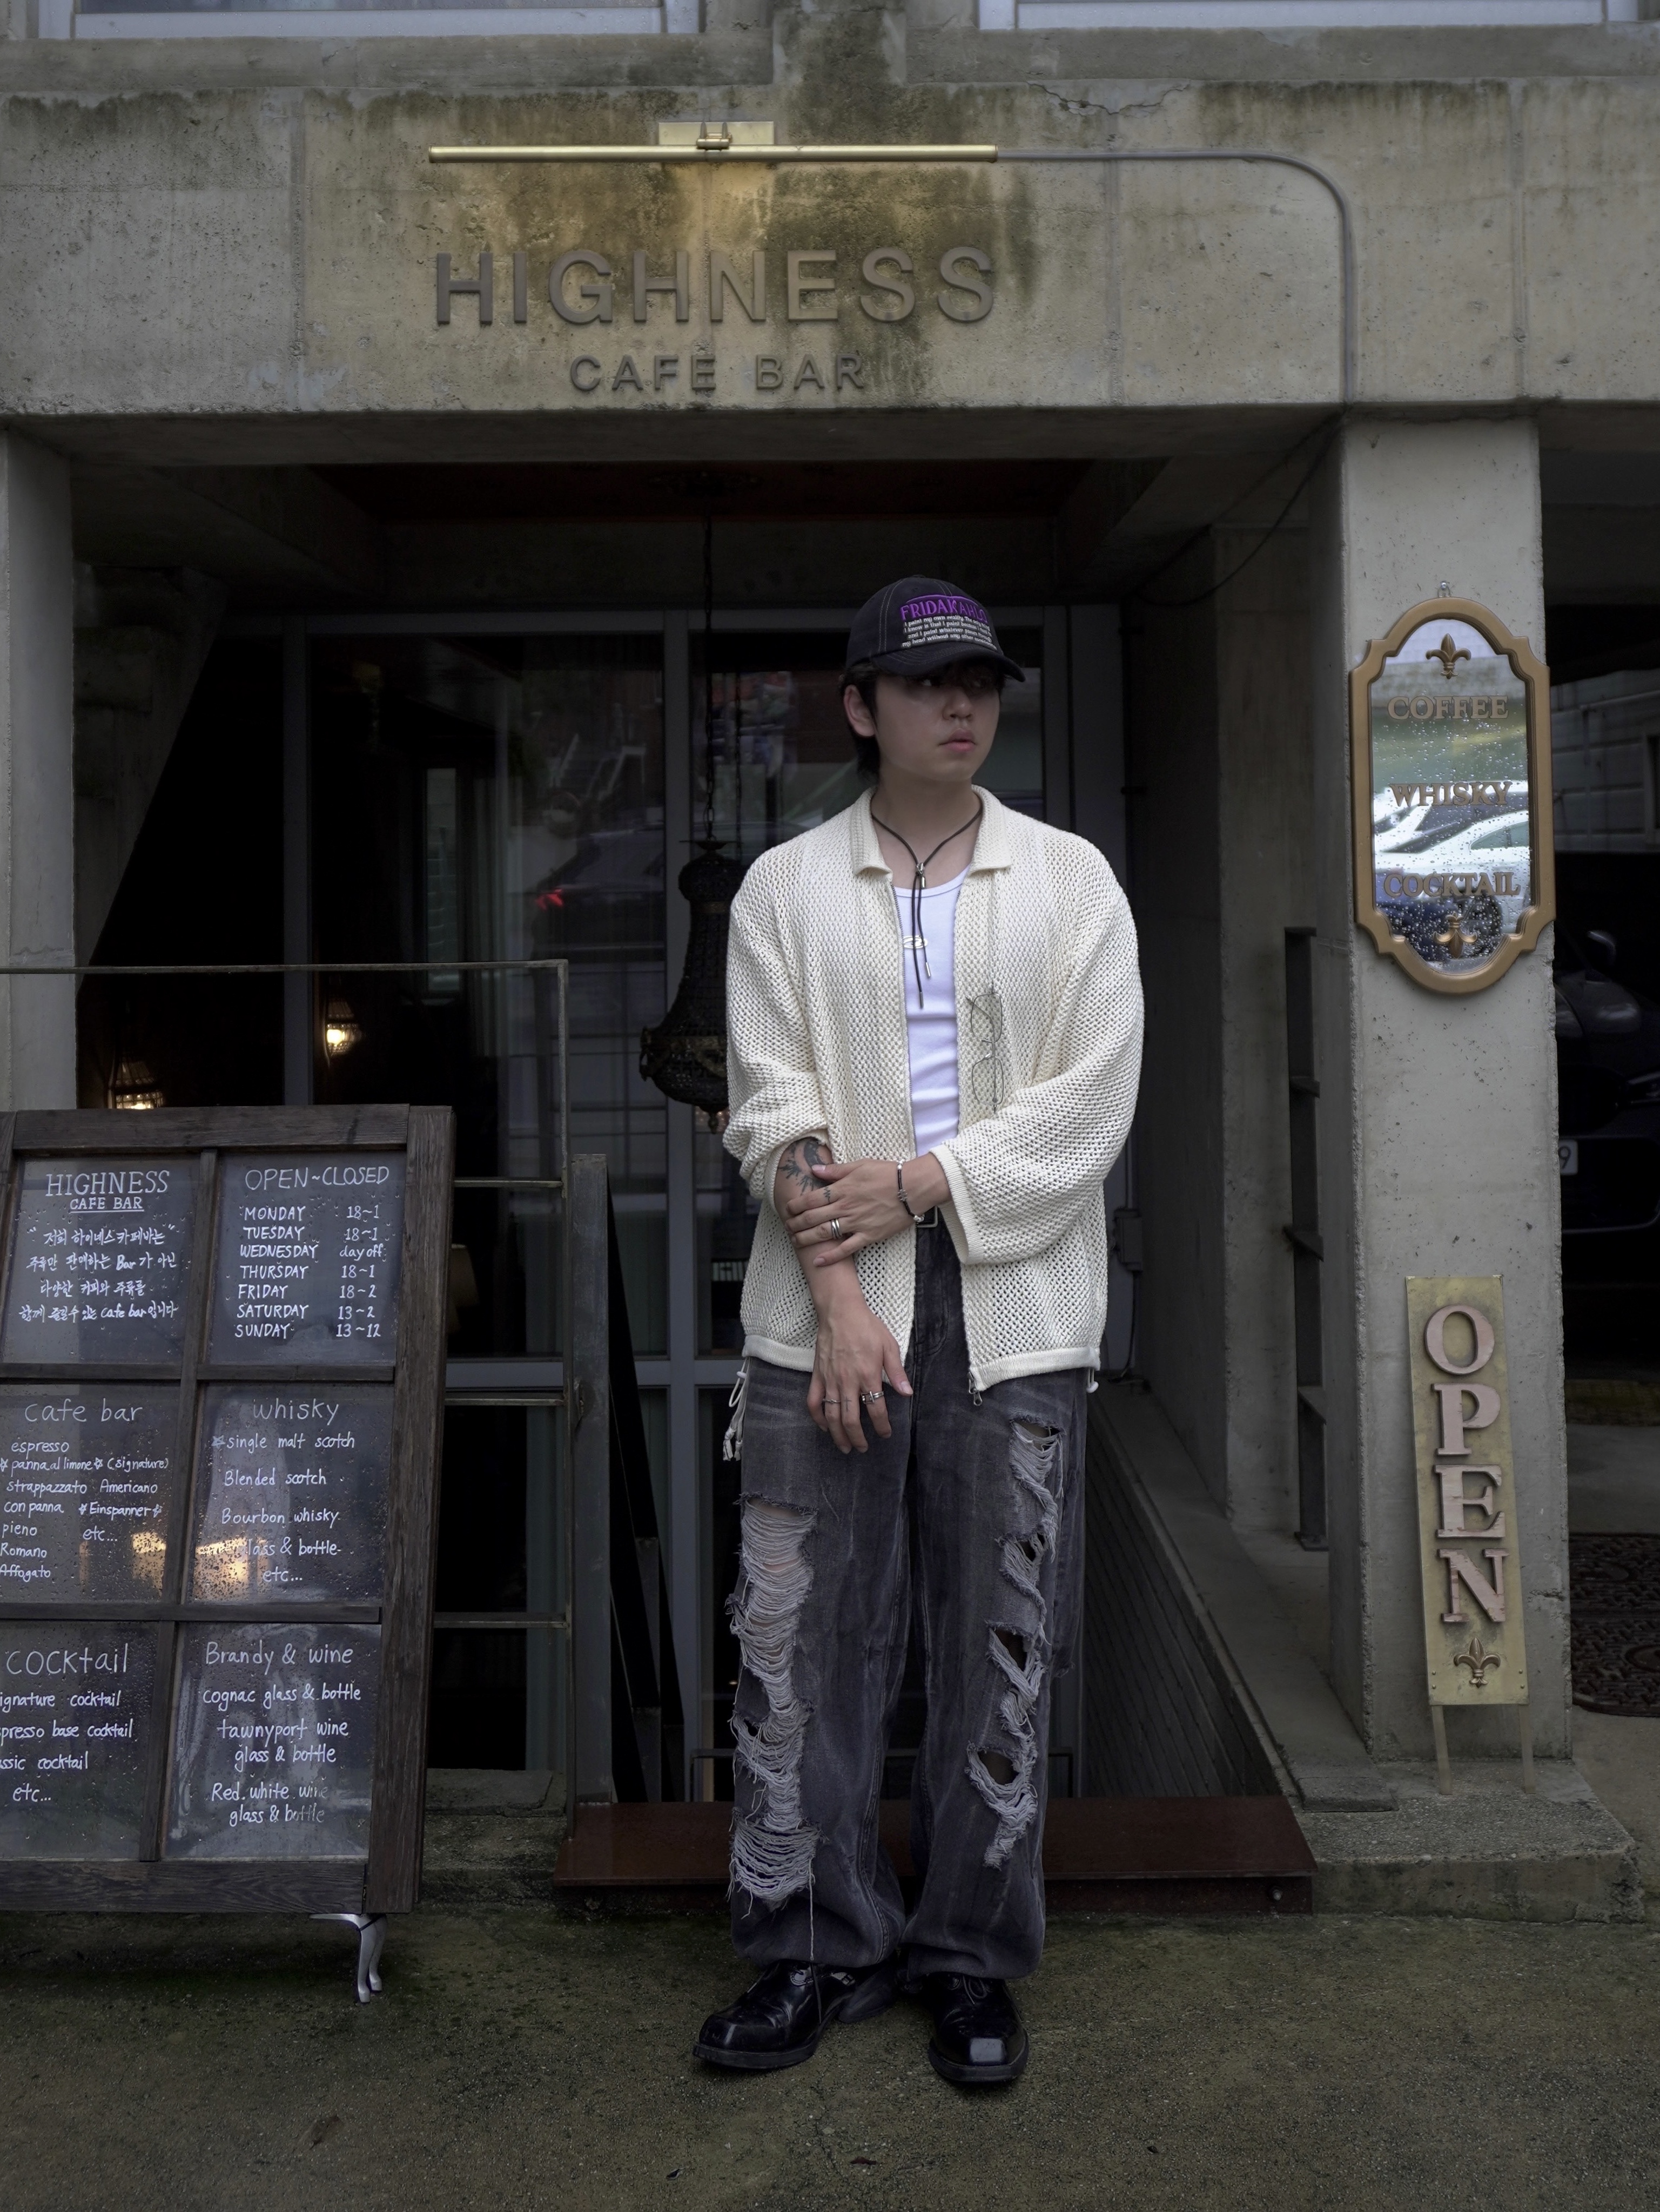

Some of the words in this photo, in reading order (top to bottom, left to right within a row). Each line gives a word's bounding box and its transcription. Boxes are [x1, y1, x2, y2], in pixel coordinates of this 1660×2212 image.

[436, 247, 994, 325] HIGHNESS
[570, 354, 717, 392] CAFE
[756, 353, 864, 390] BAR
[900, 599, 948, 621] FRIDA
[909, 618, 922, 627] paint
[924, 629, 938, 637] paint
[1388, 695, 1509, 720] COFFEE
[1389, 781, 1514, 807] WHISKY
[1383, 872, 1521, 899] COCKTAIL
[45, 1170, 170, 1197] HIGHNESS
[70, 1197, 106, 1210] CAFE
[113, 1196, 143, 1210] BAR
[244, 1205, 306, 1221] MONDAY
[43, 1228, 67, 1246] 저희
[243, 1226, 305, 1241] TUESDAY
[240, 1244, 319, 1259] WEDNESDAY
[26, 1253, 58, 1272] 주류만
[65, 1252, 112, 1270] 판매하는
[157, 1252, 177, 1268] 아닌
[240, 1264, 309, 1279] THURSDAY
[40, 1279, 74, 1297] 다양한
[80, 1278, 110, 1296] 커피와
[113, 1278, 146, 1297] 주류를
[238, 1284, 288, 1299] FRIDAY
[18, 1304, 45, 1323] 함께
[237, 1304, 309, 1319] SATURDAY
[234, 1323, 291, 1339] SUNDAY
[100, 1398, 143, 1422] bar
[11, 1441, 70, 1460] espresso
[227, 1432, 268, 1454] single
[278, 1432, 306, 1448] malt
[315, 1431, 355, 1448] scotch
[11, 1460, 50, 1478] panna
[64, 1458, 93, 1470] limone
[1423, 1304, 1510, 1623] OPEN
[99, 1479, 158, 1494] Americano
[225, 1467, 276, 1486] Blended
[285, 1468, 327, 1485] scotch
[4, 1501, 26, 1513] con
[28, 1502, 64, 1518] panna
[89, 1501, 152, 1521] Einspanner
[221, 1507, 285, 1524] Bourbon
[294, 1507, 339, 1529] whisky
[2, 1521, 37, 1538] pieno
[0, 1542, 48, 1558] Romano
[280, 1536, 292, 1555] &
[299, 1538, 338, 1556] bottle
[0, 1563, 51, 1582] Affogato
[206, 1639, 274, 1675] Brandy
[281, 1643, 295, 1664] &
[309, 1644, 354, 1664] wine
[0, 1691, 56, 1713] ignature
[70, 1690, 122, 1707] cocktail
[203, 1689, 256, 1712] cognac
[265, 1684, 297, 1709] glass
[302, 1683, 315, 1700] &
[321, 1682, 361, 1701] bottle
[0, 1725, 45, 1746] presso
[52, 1719, 79, 1737] base
[87, 1718, 133, 1738] cocktail
[317, 1718, 349, 1736] wine
[38, 1750, 89, 1770] cocktail
[234, 1746, 270, 1772] glass
[274, 1745, 285, 1762] &
[293, 1743, 337, 1763] bottle
[229, 1803, 264, 1827] glass
[270, 1804, 280, 1823] &
